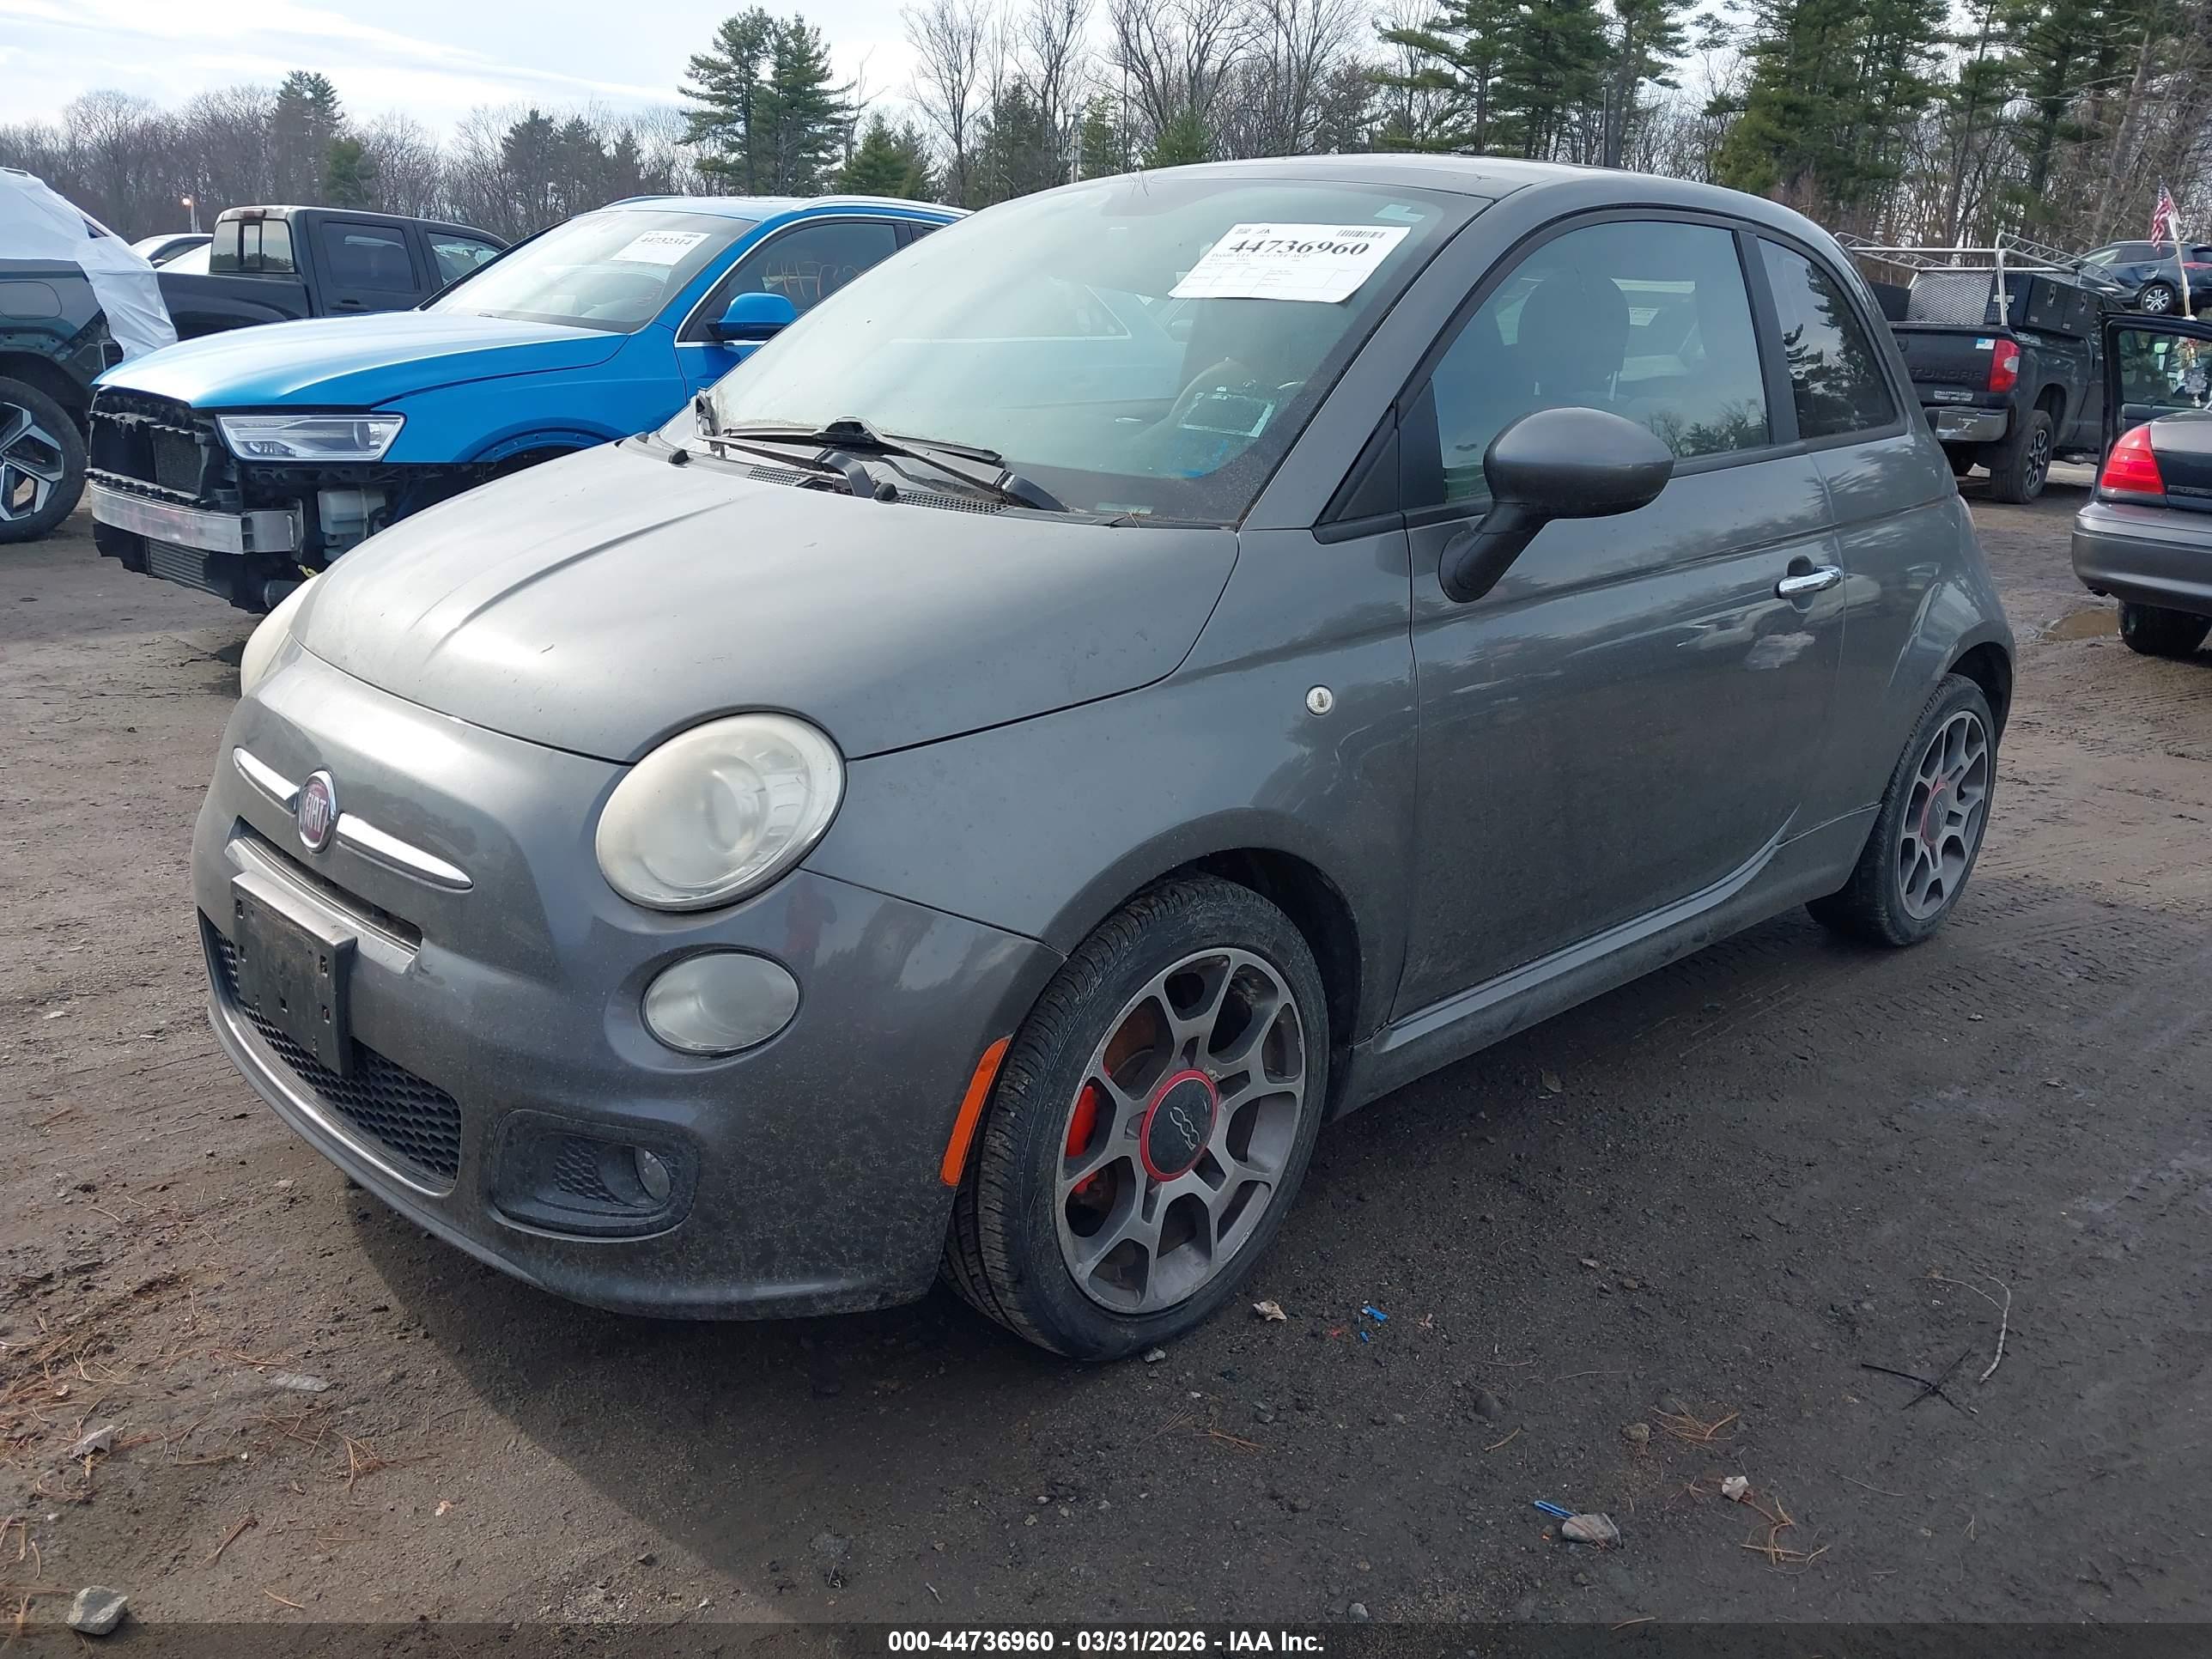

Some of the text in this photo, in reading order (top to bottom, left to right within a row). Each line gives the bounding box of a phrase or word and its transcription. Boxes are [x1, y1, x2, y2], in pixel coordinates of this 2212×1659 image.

[1229, 240, 1370, 256] 44736960
[1910, 368, 1985, 380] TUNDRA
[304, 792, 326, 832] FIAT
